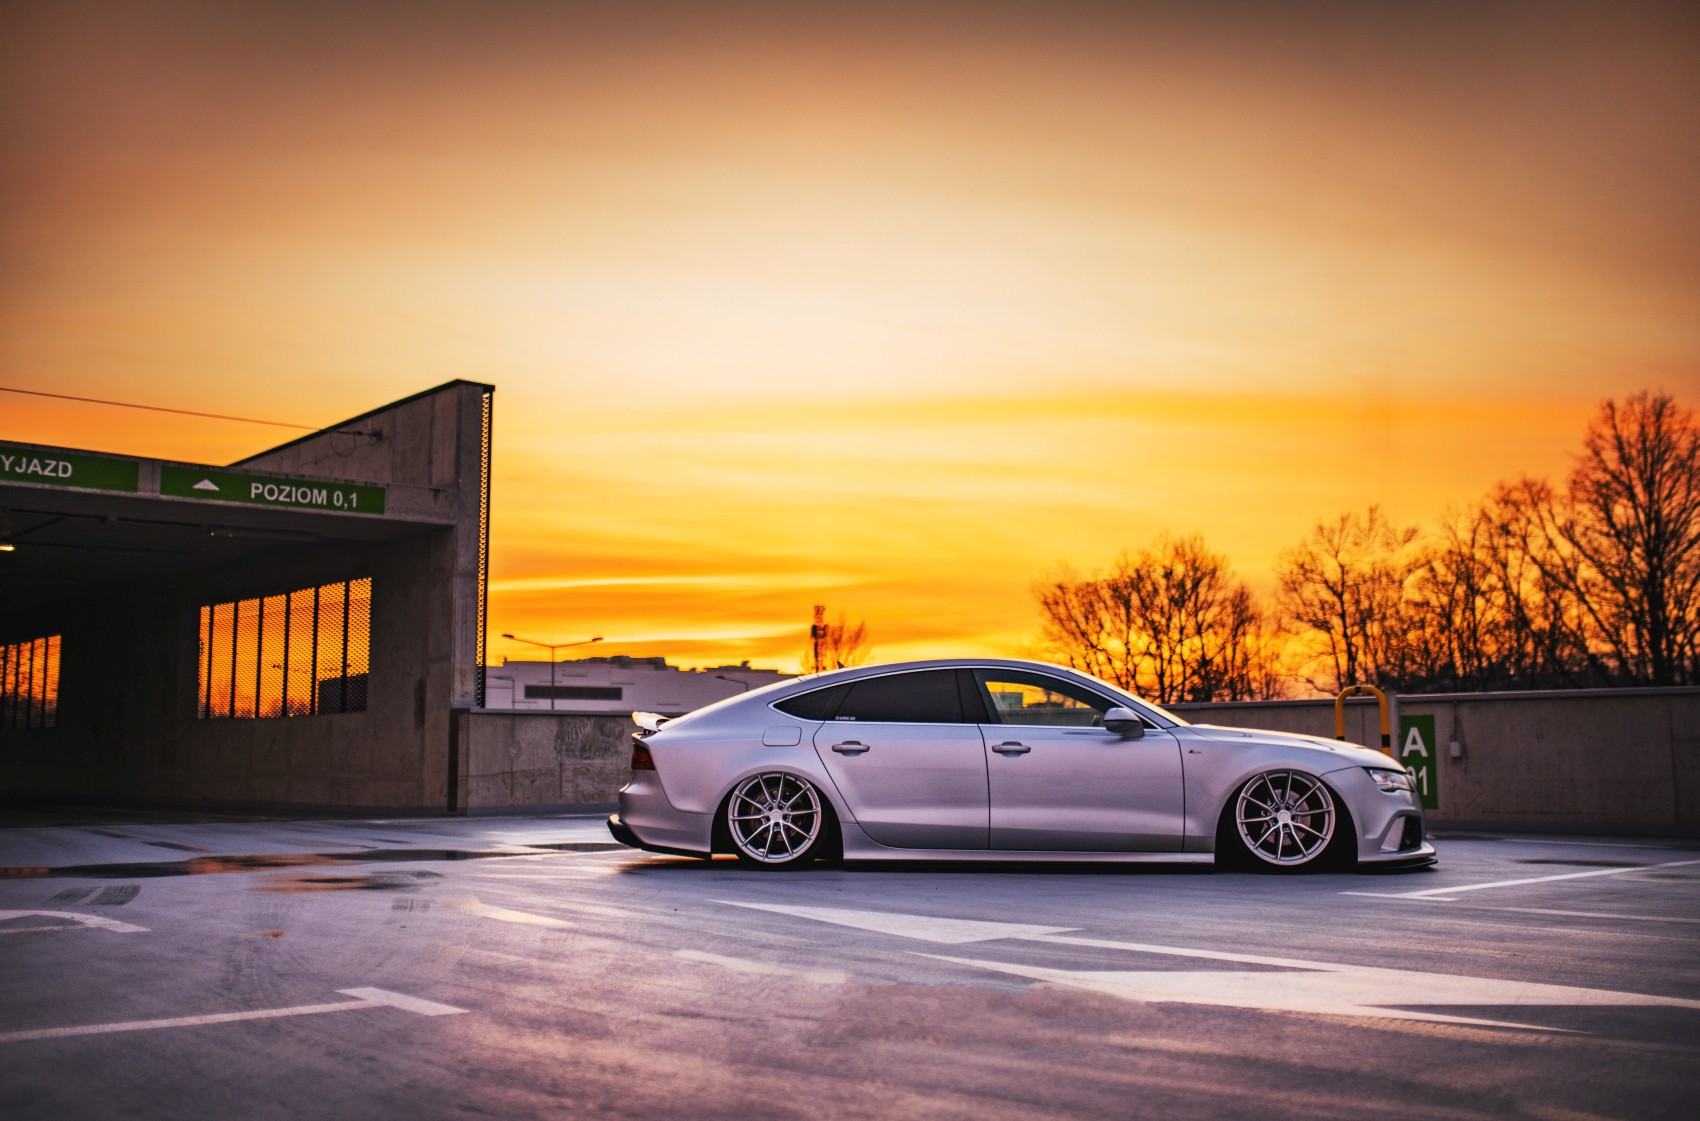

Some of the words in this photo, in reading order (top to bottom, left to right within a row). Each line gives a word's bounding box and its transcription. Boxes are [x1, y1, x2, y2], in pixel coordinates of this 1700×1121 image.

[0, 454, 72, 478] YJAZD
[250, 482, 327, 506] POZIOM
[333, 490, 357, 510] 0,1
[1402, 727, 1428, 757] A
